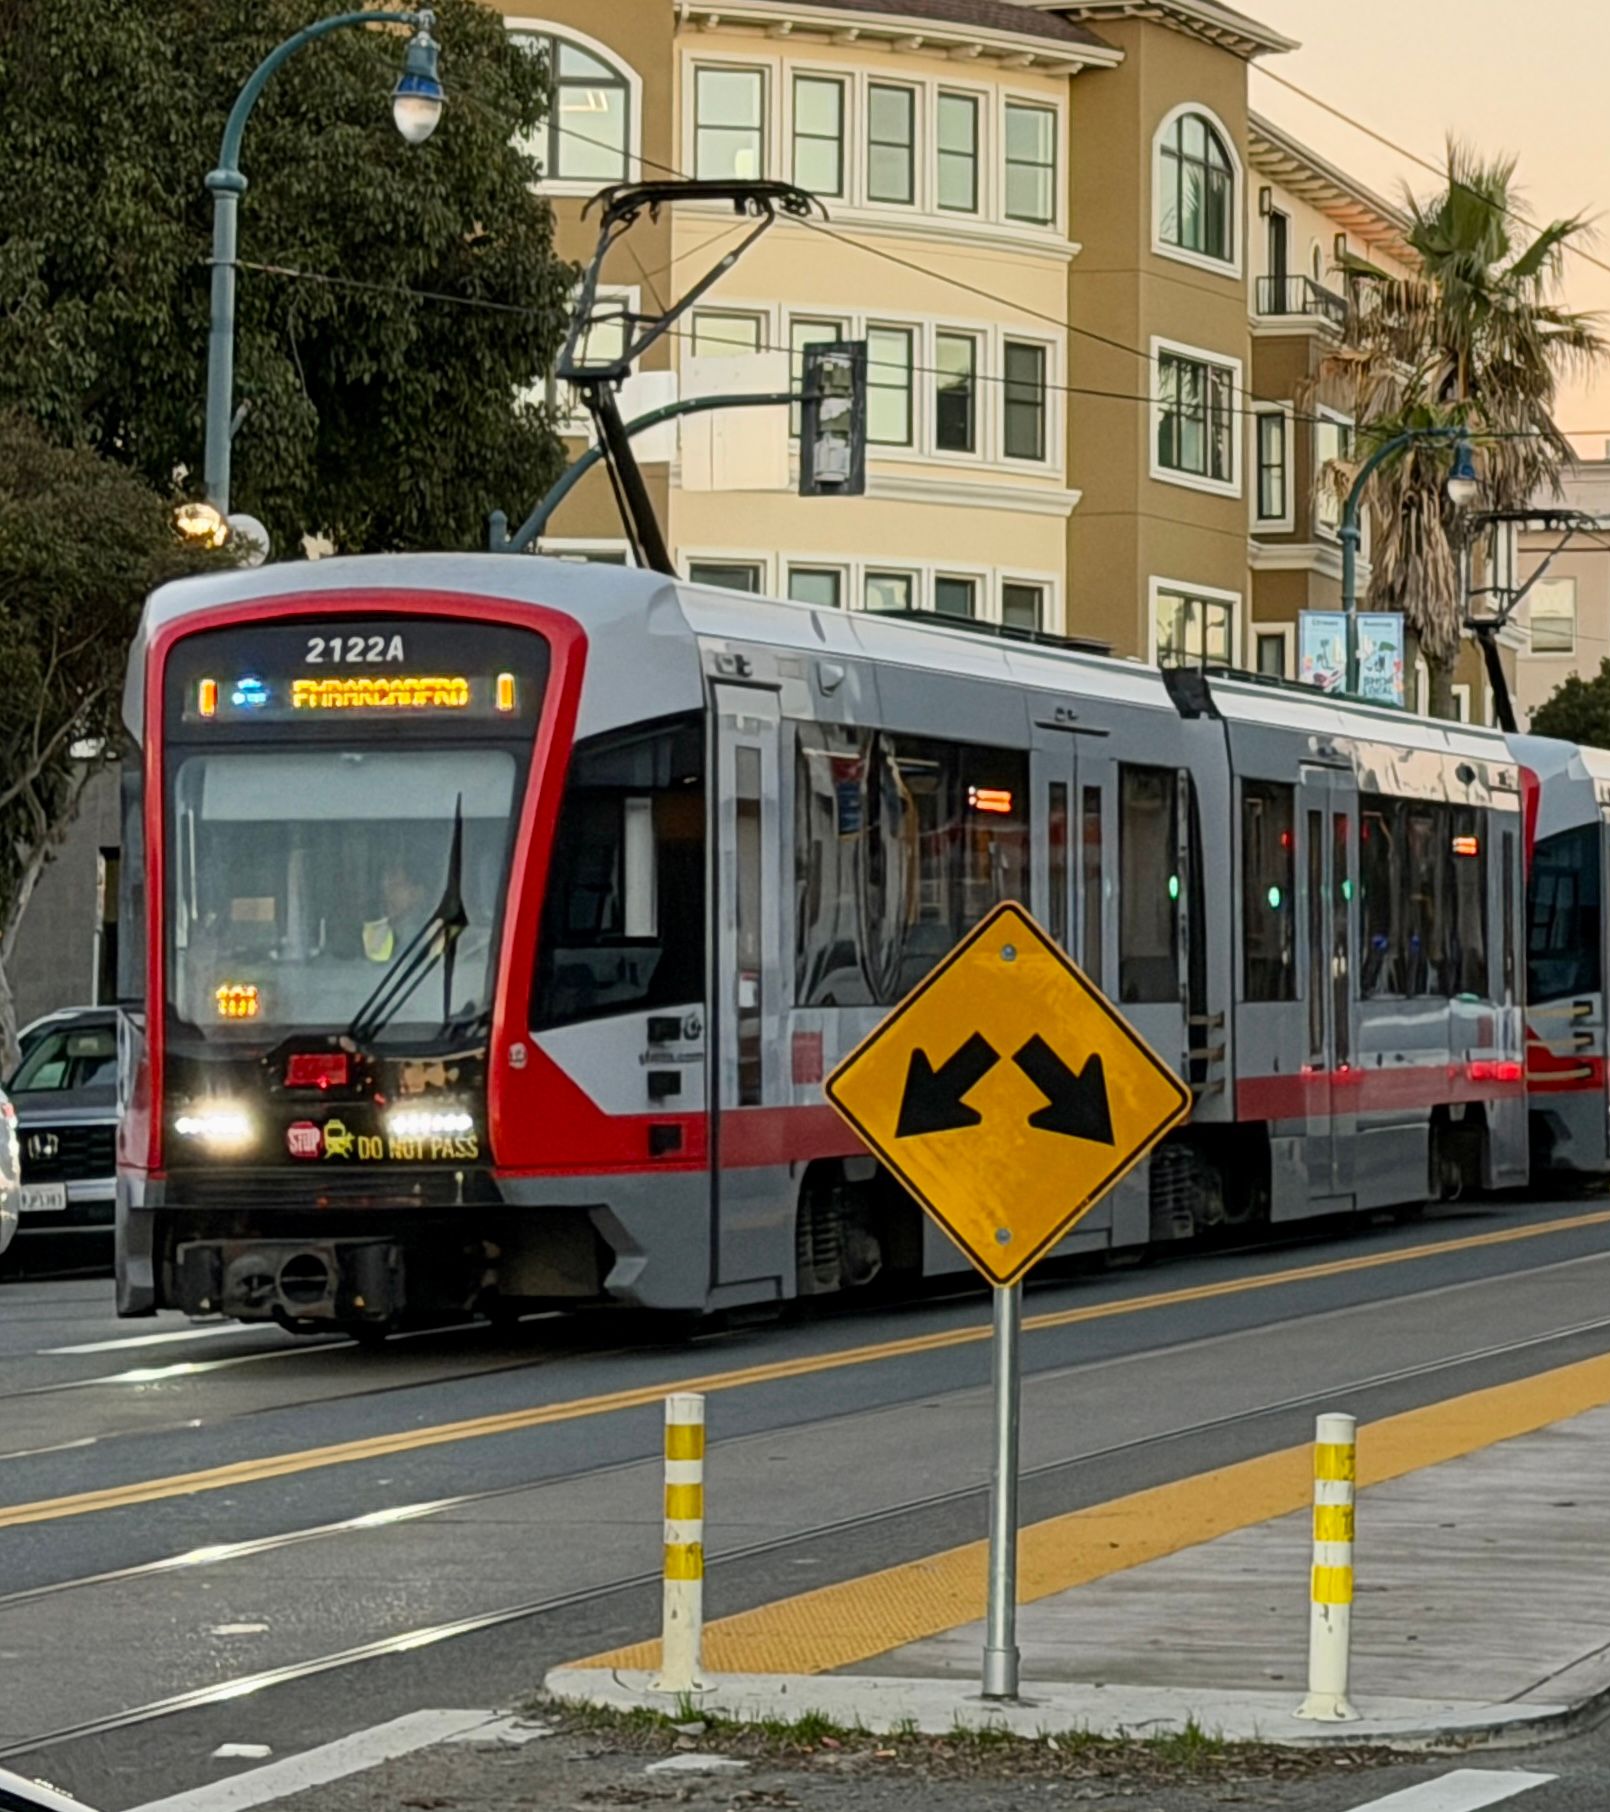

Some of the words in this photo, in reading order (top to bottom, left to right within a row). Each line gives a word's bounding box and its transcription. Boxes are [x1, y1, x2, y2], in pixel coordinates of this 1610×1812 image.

[305, 635, 404, 663] 2122A
[287, 1127, 320, 1156] STOP
[358, 1136, 383, 1160] DO
[389, 1135, 426, 1160] NOT
[431, 1134, 479, 1160] PASS
